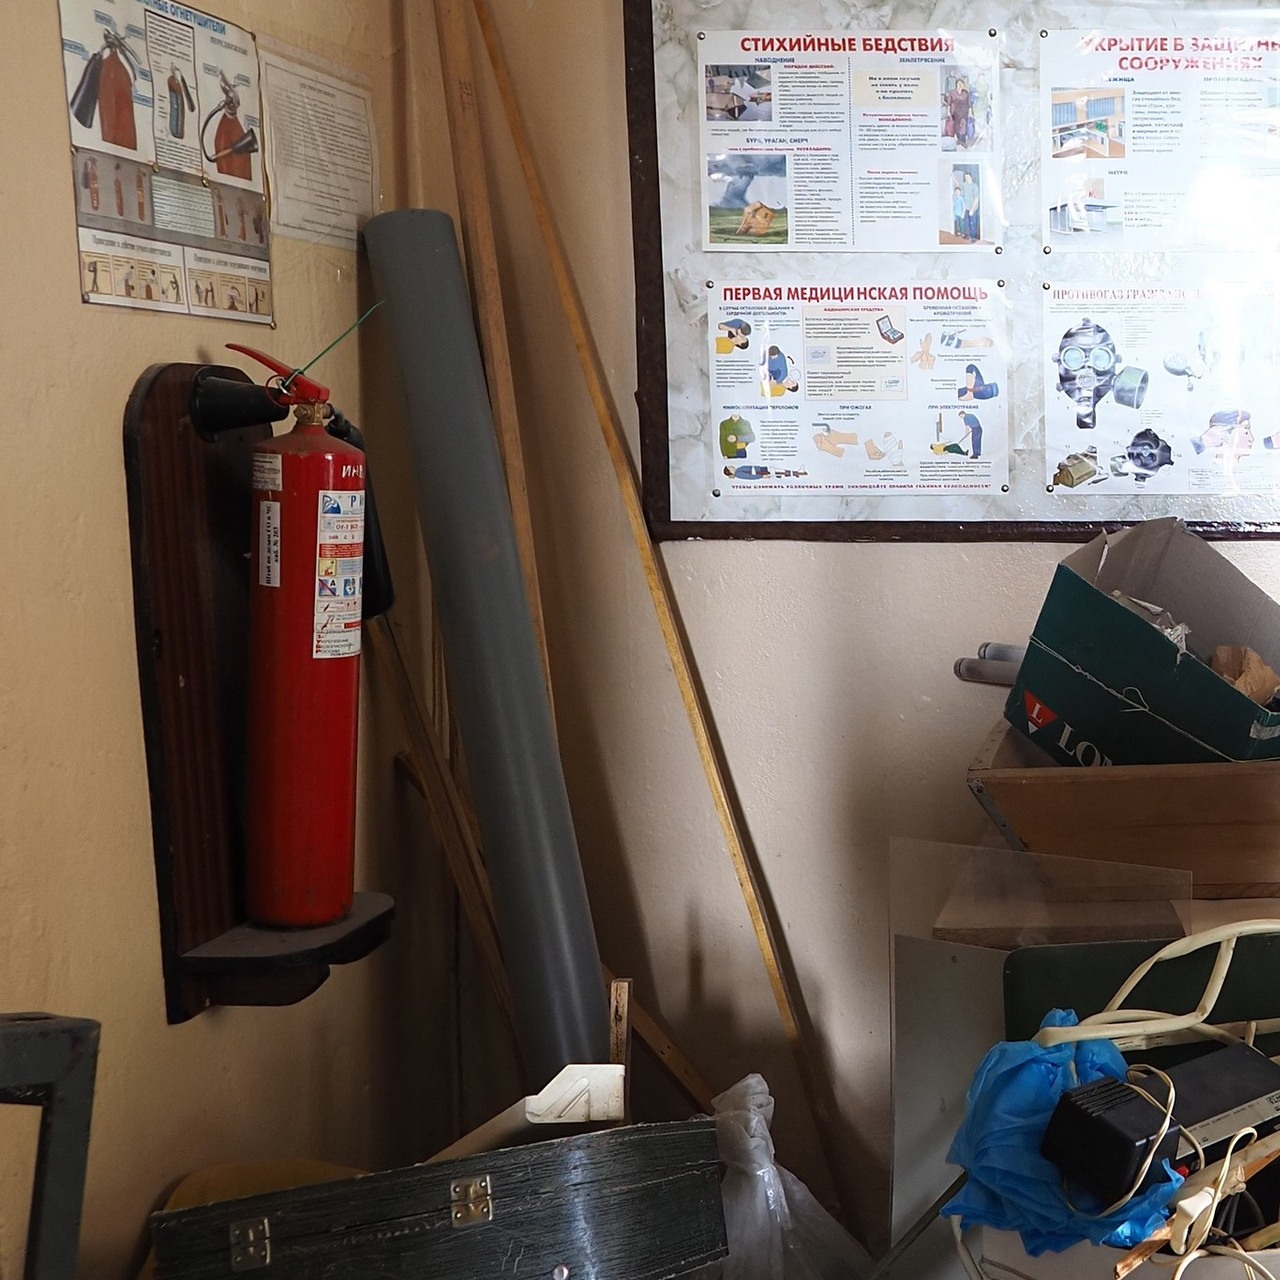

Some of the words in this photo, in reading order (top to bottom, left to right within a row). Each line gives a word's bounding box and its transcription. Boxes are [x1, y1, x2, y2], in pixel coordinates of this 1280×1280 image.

[169, 1, 226, 36] ОГНЕТУШИТЕЛИ
[740, 34, 857, 53] СТИХИЙНЫЕ
[862, 37, 955, 54] БЕДСТВИЯ
[1118, 56, 1263, 71] СООРУЖЕНИЯХ
[723, 286, 782, 302] ПЕРВАЯ
[786, 287, 908, 303] МЕДИЦИНСКАЯ
[912, 286, 988, 303] ПОМОЩЬ
[1053, 289, 1124, 300] ПРОТИВОГАЗ
[1030, 703, 1044, 724] L
[1057, 721, 1113, 767] LO
